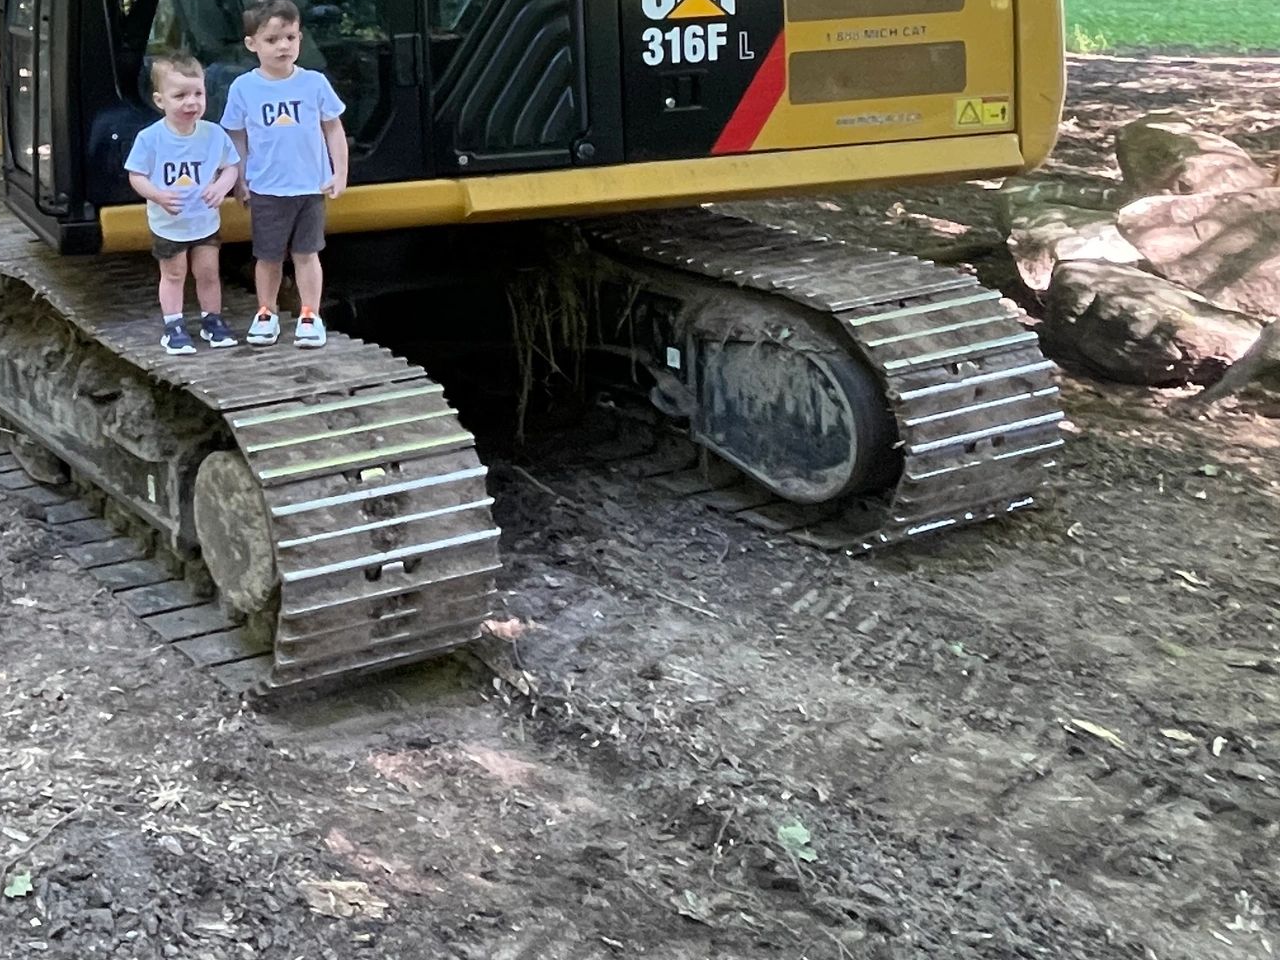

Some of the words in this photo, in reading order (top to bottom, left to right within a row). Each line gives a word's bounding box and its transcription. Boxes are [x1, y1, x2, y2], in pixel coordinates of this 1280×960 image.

[641, 23, 728, 66] 316F
[738, 31, 755, 60] L
[863, 28, 898, 39] MICH
[902, 25, 927, 37] CAT
[261, 100, 301, 127] CAT
[163, 161, 202, 186] CAT
